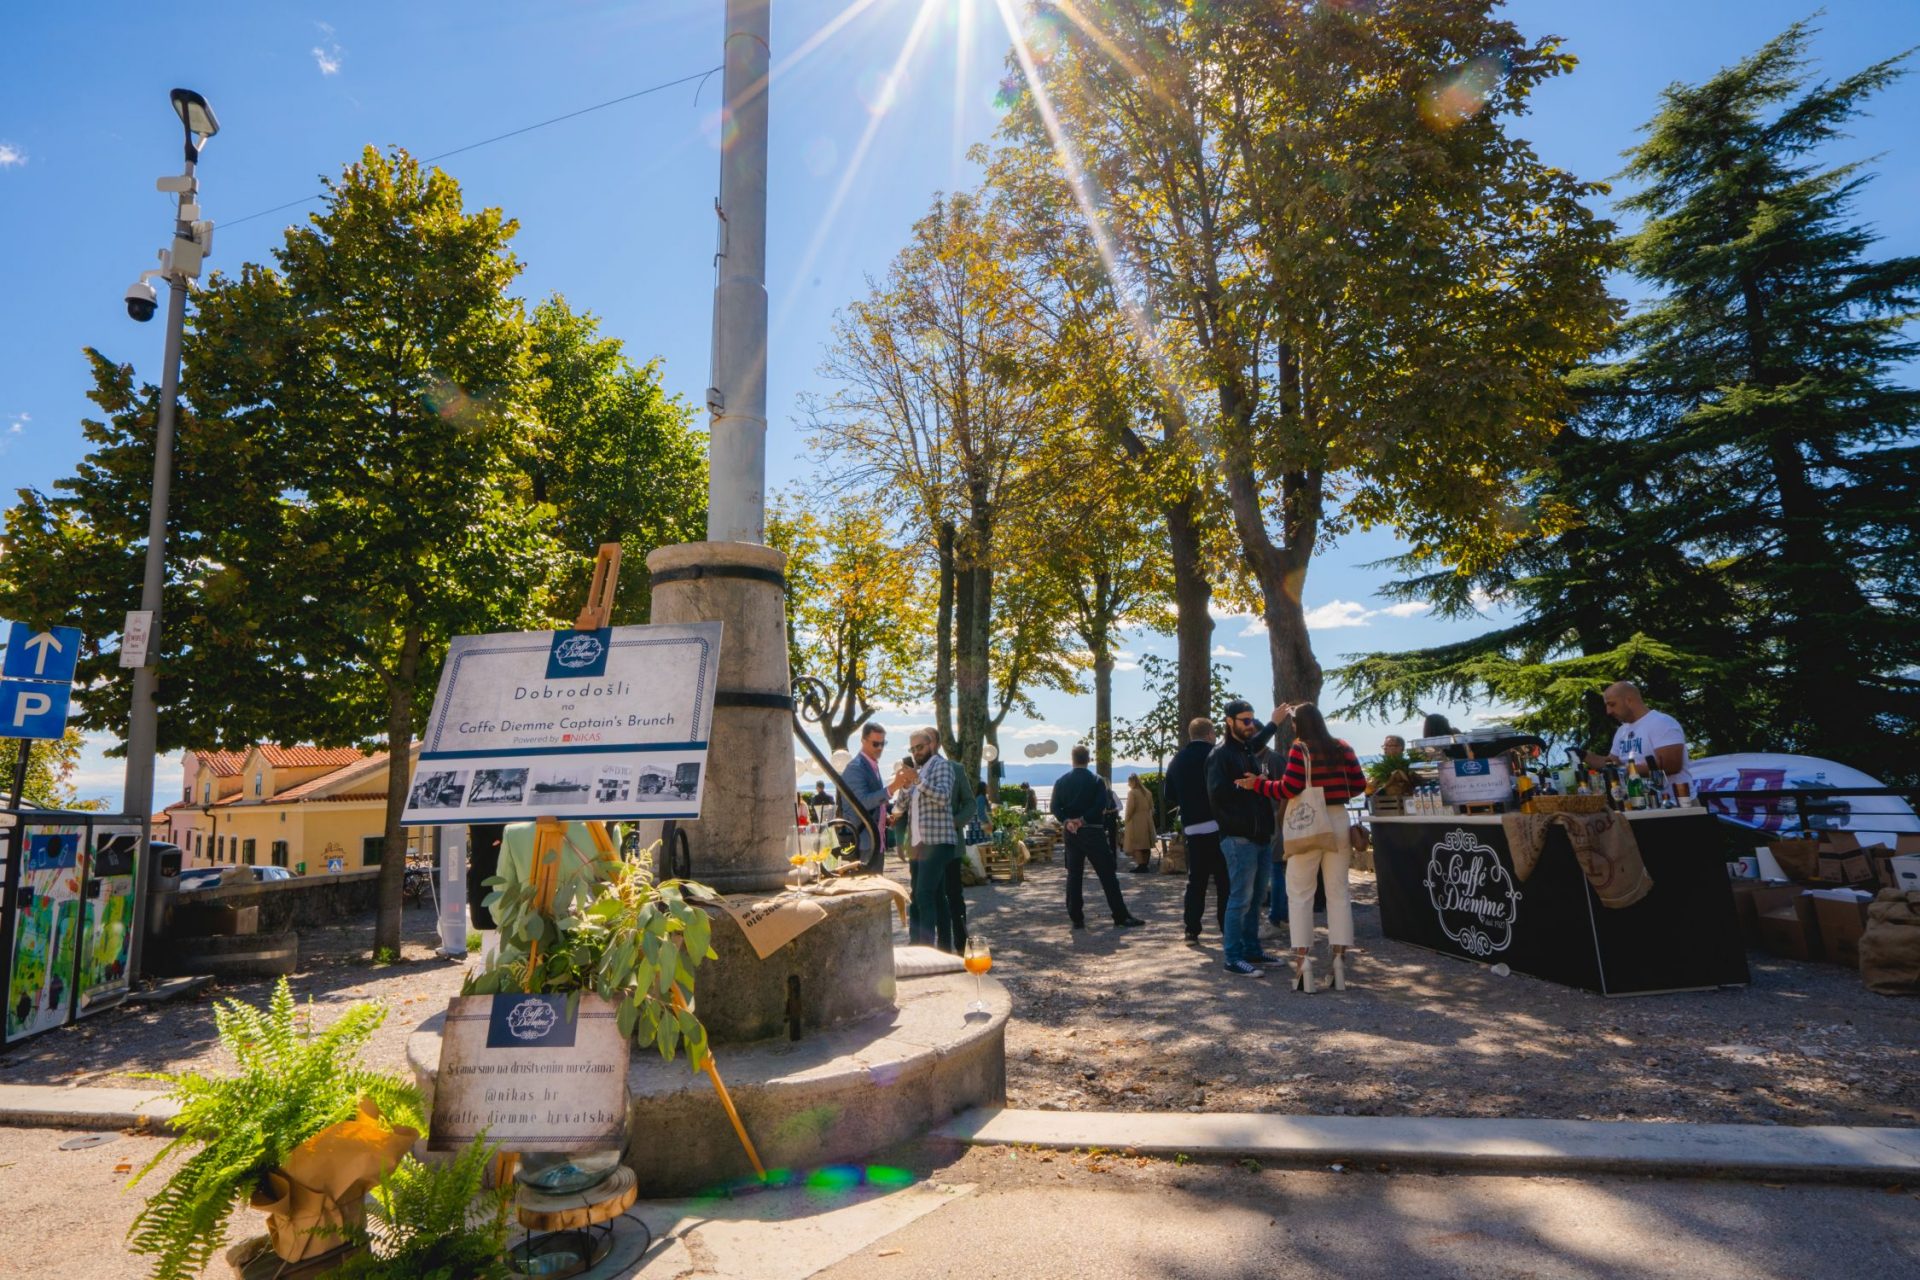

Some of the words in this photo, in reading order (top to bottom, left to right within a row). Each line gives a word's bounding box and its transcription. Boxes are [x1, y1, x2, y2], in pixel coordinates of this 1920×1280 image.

[514, 681, 630, 700] Dobrodošli
[13, 691, 51, 727] P
[459, 720, 496, 734] Caffe
[500, 720, 555, 733] Diemme
[559, 716, 622, 731] Captain's
[628, 713, 675, 727] Brunch
[513, 735, 547, 744] Powered
[550, 735, 559, 744] by
[570, 733, 601, 742] NIKAS
[1442, 854, 1487, 897] Caffé
[1438, 883, 1506, 921] Diemme
[478, 1064, 494, 1074] smo
[497, 1064, 508, 1074] na
